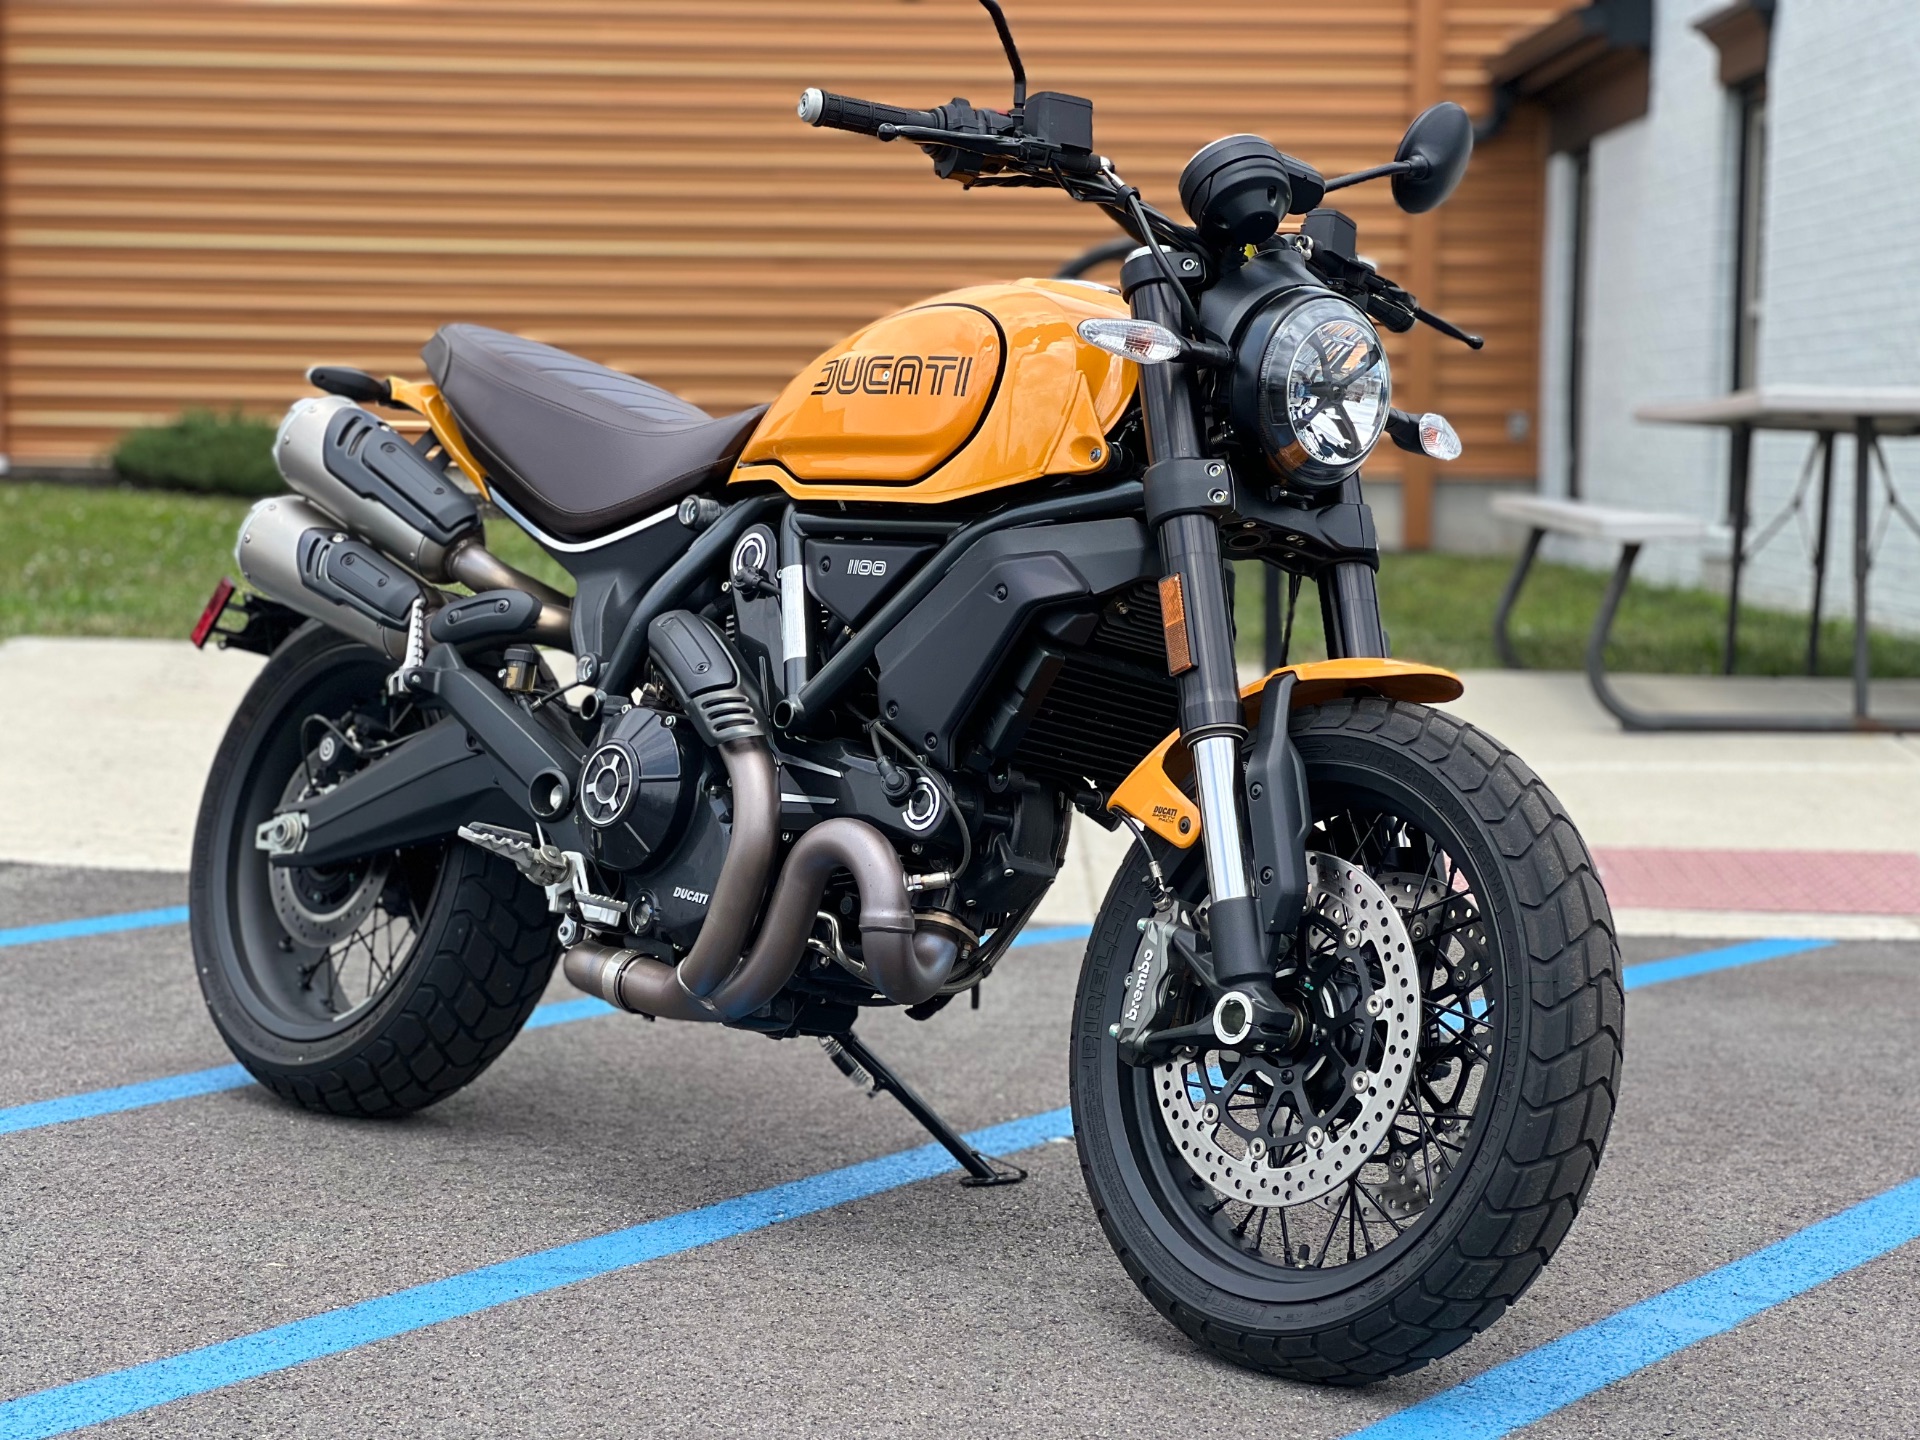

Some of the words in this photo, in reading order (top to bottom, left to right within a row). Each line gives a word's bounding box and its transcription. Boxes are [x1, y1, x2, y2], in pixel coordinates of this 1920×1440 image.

[811, 355, 973, 396] DUCATI
[847, 559, 887, 576] 1100
[1154, 806, 1177, 816] DUCATI
[672, 886, 709, 905] DUCATI
[1079, 907, 1129, 1058] PIRELLI
[1125, 949, 1153, 1021] brembo
